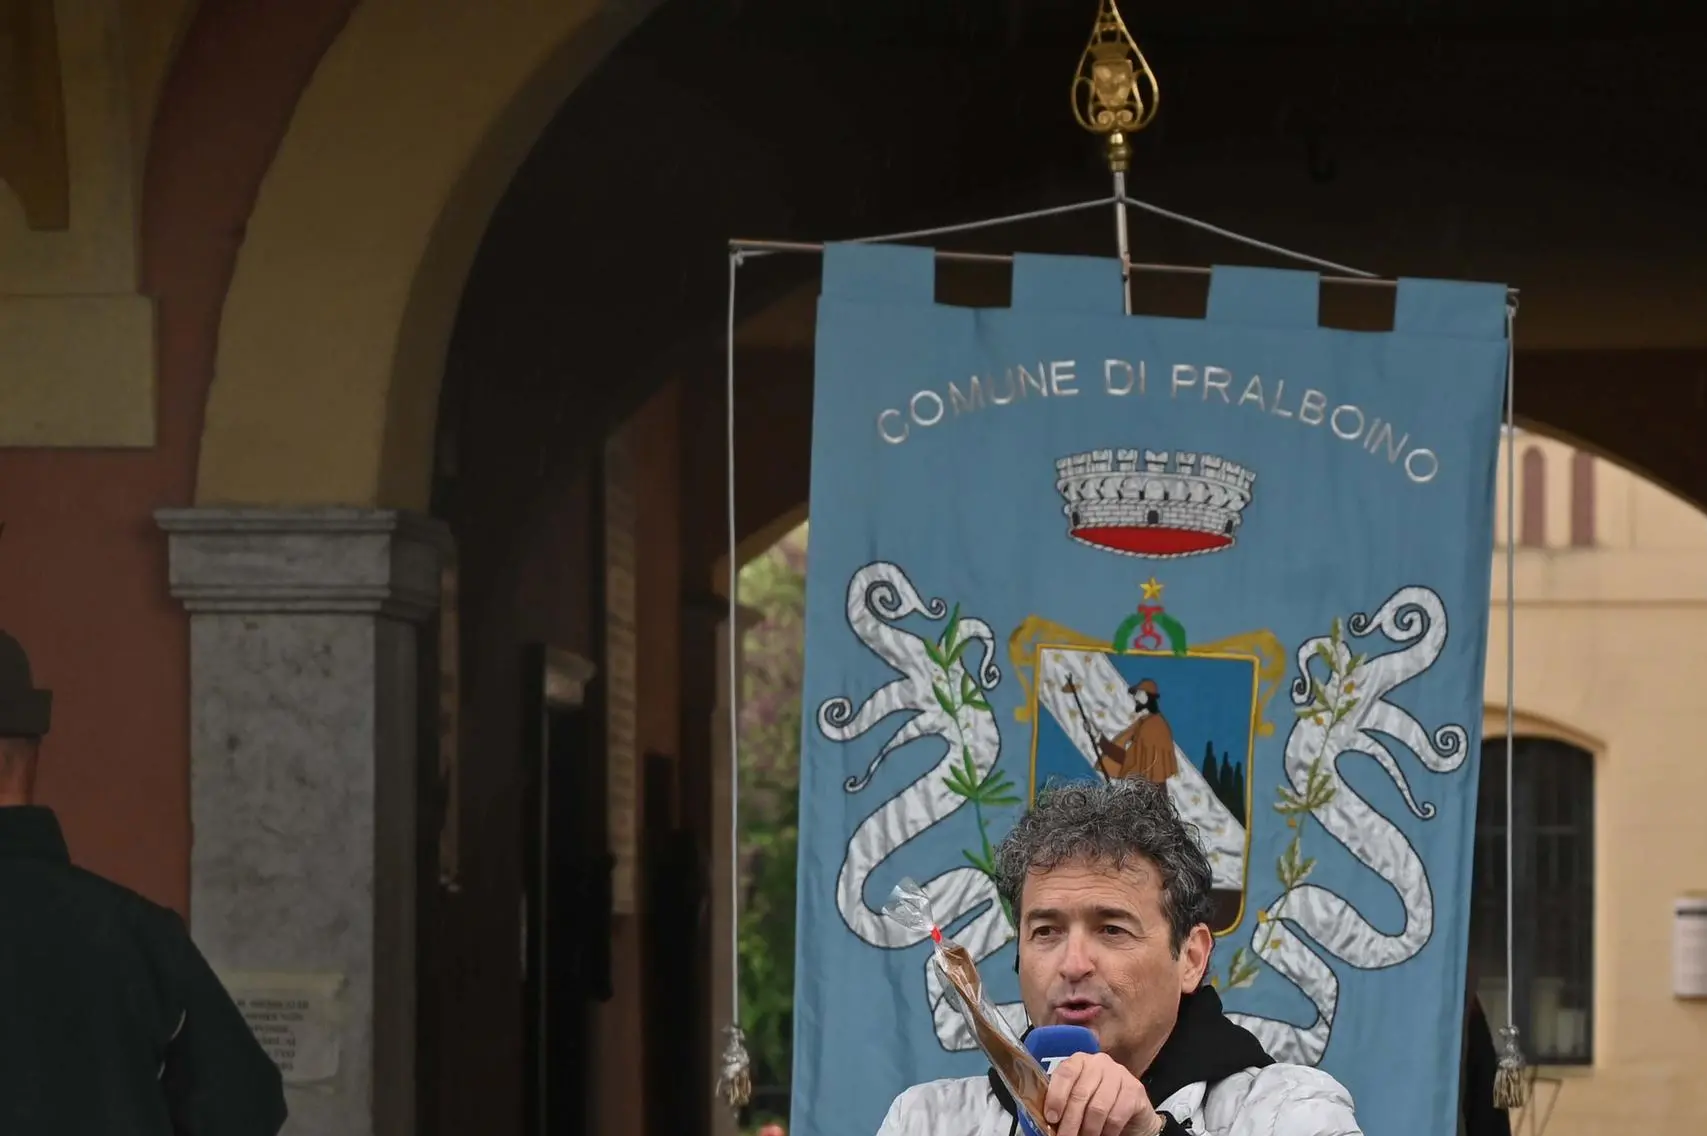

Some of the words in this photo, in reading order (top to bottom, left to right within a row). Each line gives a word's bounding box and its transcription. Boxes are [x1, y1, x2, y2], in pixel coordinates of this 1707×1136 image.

[877, 360, 1078, 443] COMUNE
[1104, 358, 1146, 396] DI
[1171, 363, 1438, 482] PRALBOINO
